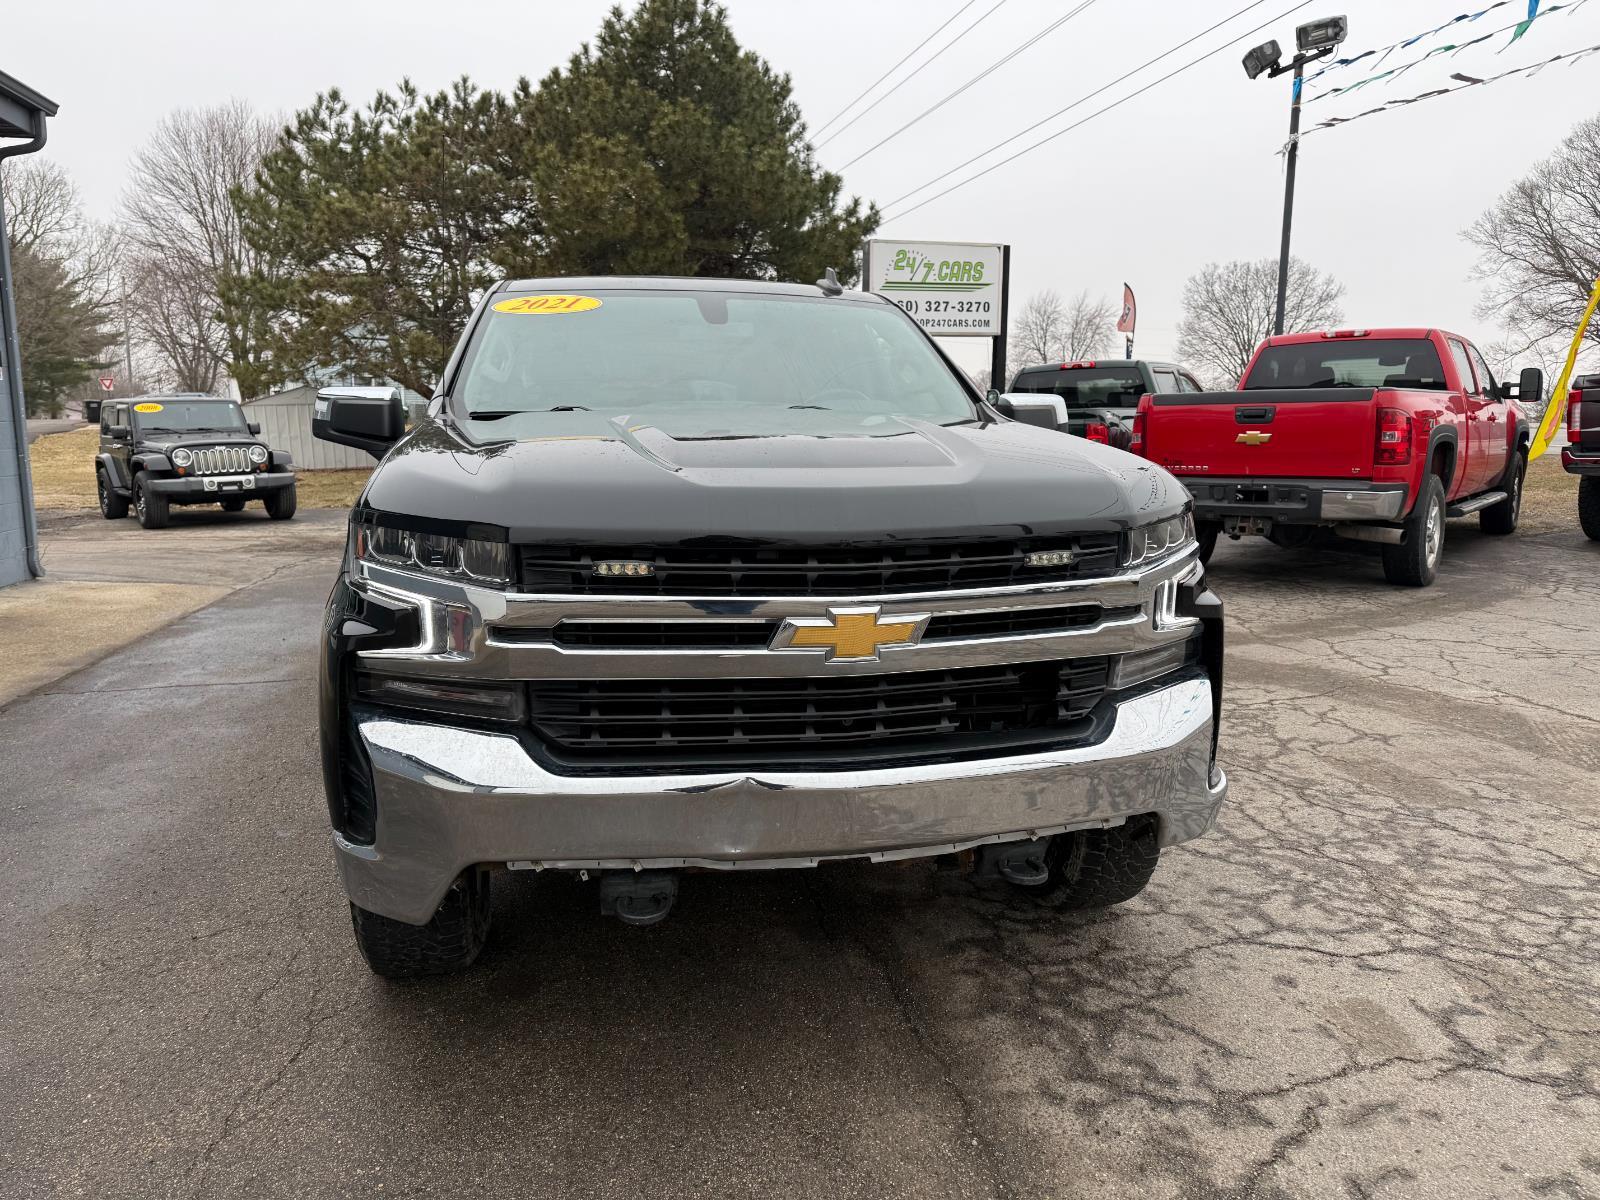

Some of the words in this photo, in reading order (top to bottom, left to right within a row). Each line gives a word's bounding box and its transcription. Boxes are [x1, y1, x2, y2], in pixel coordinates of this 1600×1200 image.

[937, 260, 985, 282] CARS
[507, 297, 581, 310] 2021
[925, 300, 990, 312] 327-3270
[916, 318, 990, 327] OP247CARS.COM
